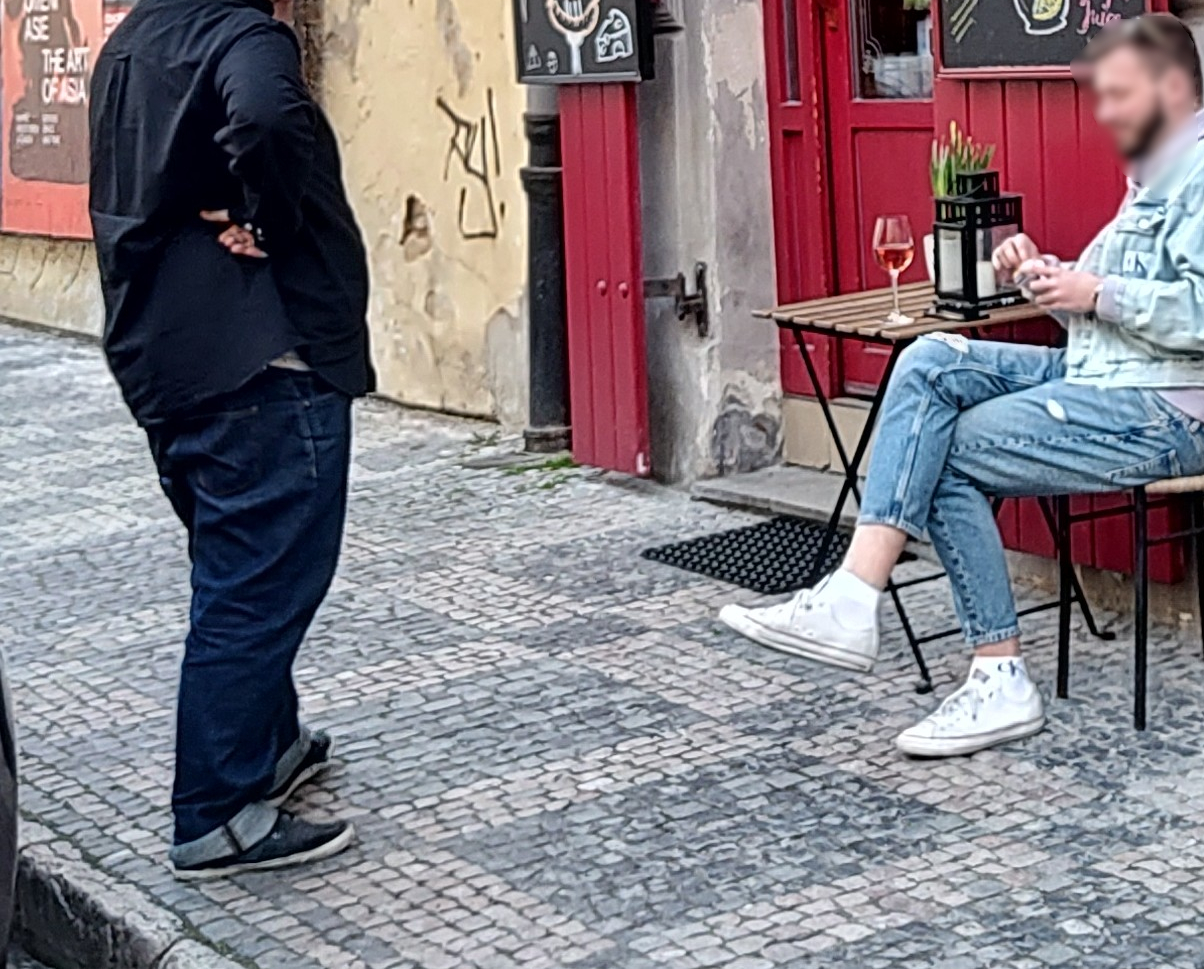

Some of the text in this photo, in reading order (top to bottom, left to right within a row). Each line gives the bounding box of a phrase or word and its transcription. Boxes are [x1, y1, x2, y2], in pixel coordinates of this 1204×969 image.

[41, 46, 92, 73] THE ART
[41, 76, 58, 104] OF
